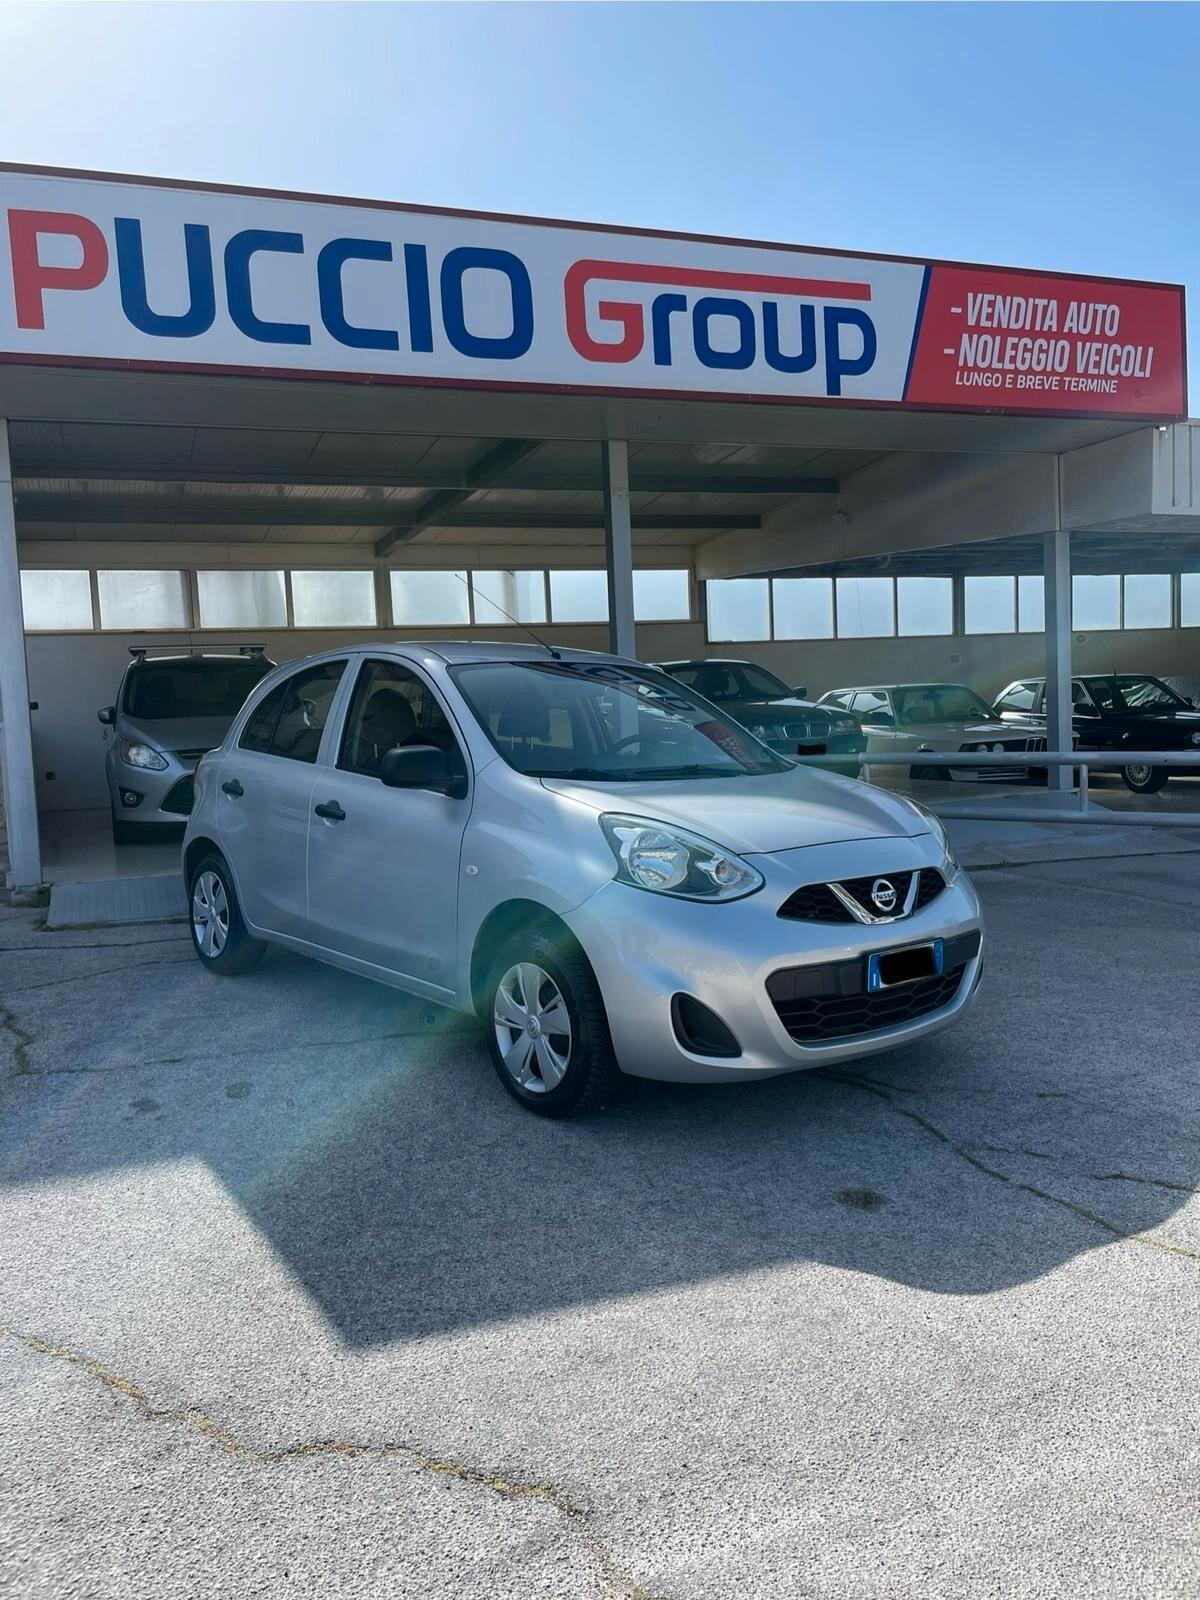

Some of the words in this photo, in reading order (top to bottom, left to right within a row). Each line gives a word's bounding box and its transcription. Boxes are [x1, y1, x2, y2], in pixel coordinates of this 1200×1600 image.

[7, 208, 534, 359] PUCCIO
[967, 292, 1057, 332] VENDITA
[1063, 301, 1120, 337] AUTO
[958, 333, 1070, 373] NOLEGGIO
[1076, 341, 1153, 378] VEICOLI
[955, 371, 1002, 388] LUNGO
[1005, 374, 1014, 388] E
[1016, 375, 1060, 390] BREVE
[1063, 377, 1118, 394] TERMINE
